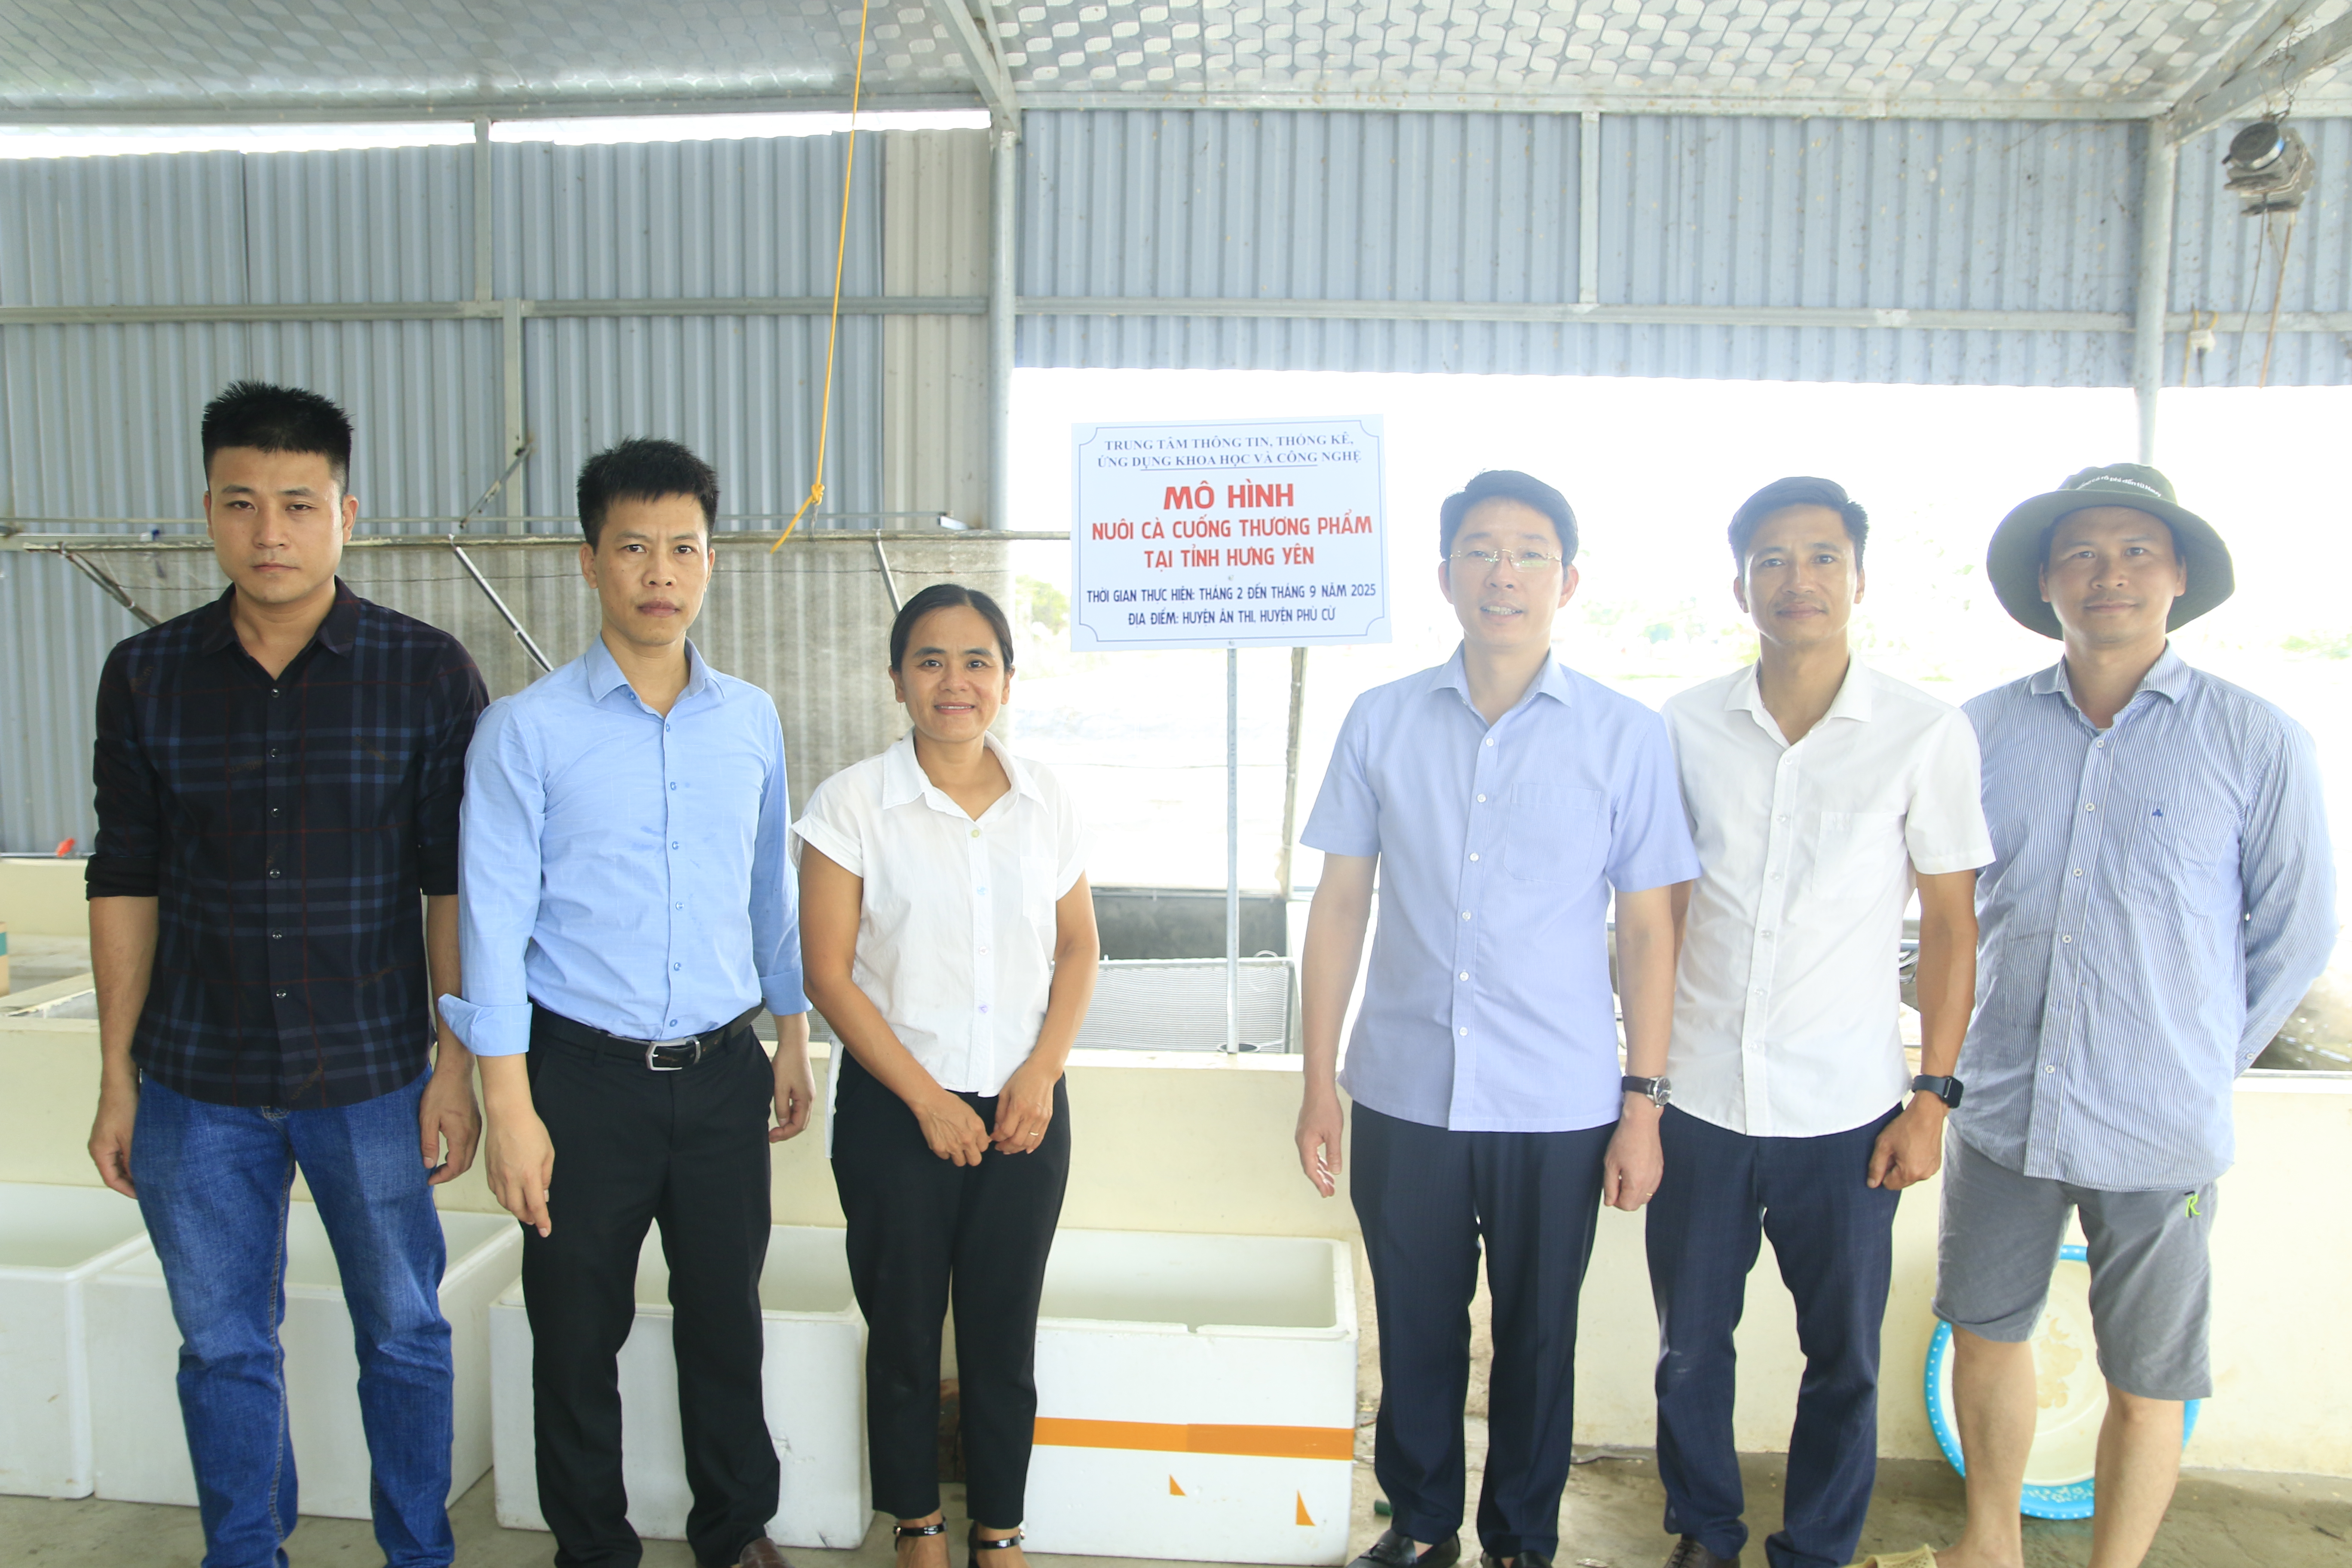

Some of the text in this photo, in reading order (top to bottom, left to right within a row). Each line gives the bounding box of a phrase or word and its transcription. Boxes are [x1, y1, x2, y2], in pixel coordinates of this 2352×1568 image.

[1105, 440, 1152, 450] TRUNG
[1158, 437, 1187, 449] TÂM
[1192, 435, 1241, 448] THÔNG
[1246, 437, 1273, 447] TIN,
[1332, 432, 1353, 444] KÊ,
[1098, 450, 1361, 469] ỨNG DỤNG KHOA HỌC VÀ CÔNG NGHỆ
[1164, 479, 1293, 510] MÔ HÌNH
[1093, 509, 1372, 540] NUÔI CÀ CUỐNG THƯƠNG PHẨM
[1144, 543, 1314, 572] TẠI TỈNH HƯNG YÊN
[1087, 587, 1109, 602] THỜI
[1114, 590, 1136, 602] GIAN
[1141, 588, 1167, 603] THỰC
[1171, 586, 1194, 603] HIỆN:
[1199, 585, 1233, 600] THÁNG
[1237, 587, 1243, 599] 2
[1247, 584, 1267, 599] ĐẾN
[1271, 583, 1305, 598] THÁNG
[1310, 585, 1316, 597] 9
[1351, 583, 1376, 596] 2025
[1128, 612, 1145, 627] ĐỊA
[1183, 609, 1215, 626] HUYỆN
[1260, 607, 1292, 625] HUYỆN
[1297, 606, 1317, 621] PHÙ
[1322, 605, 1336, 621] CỪ
